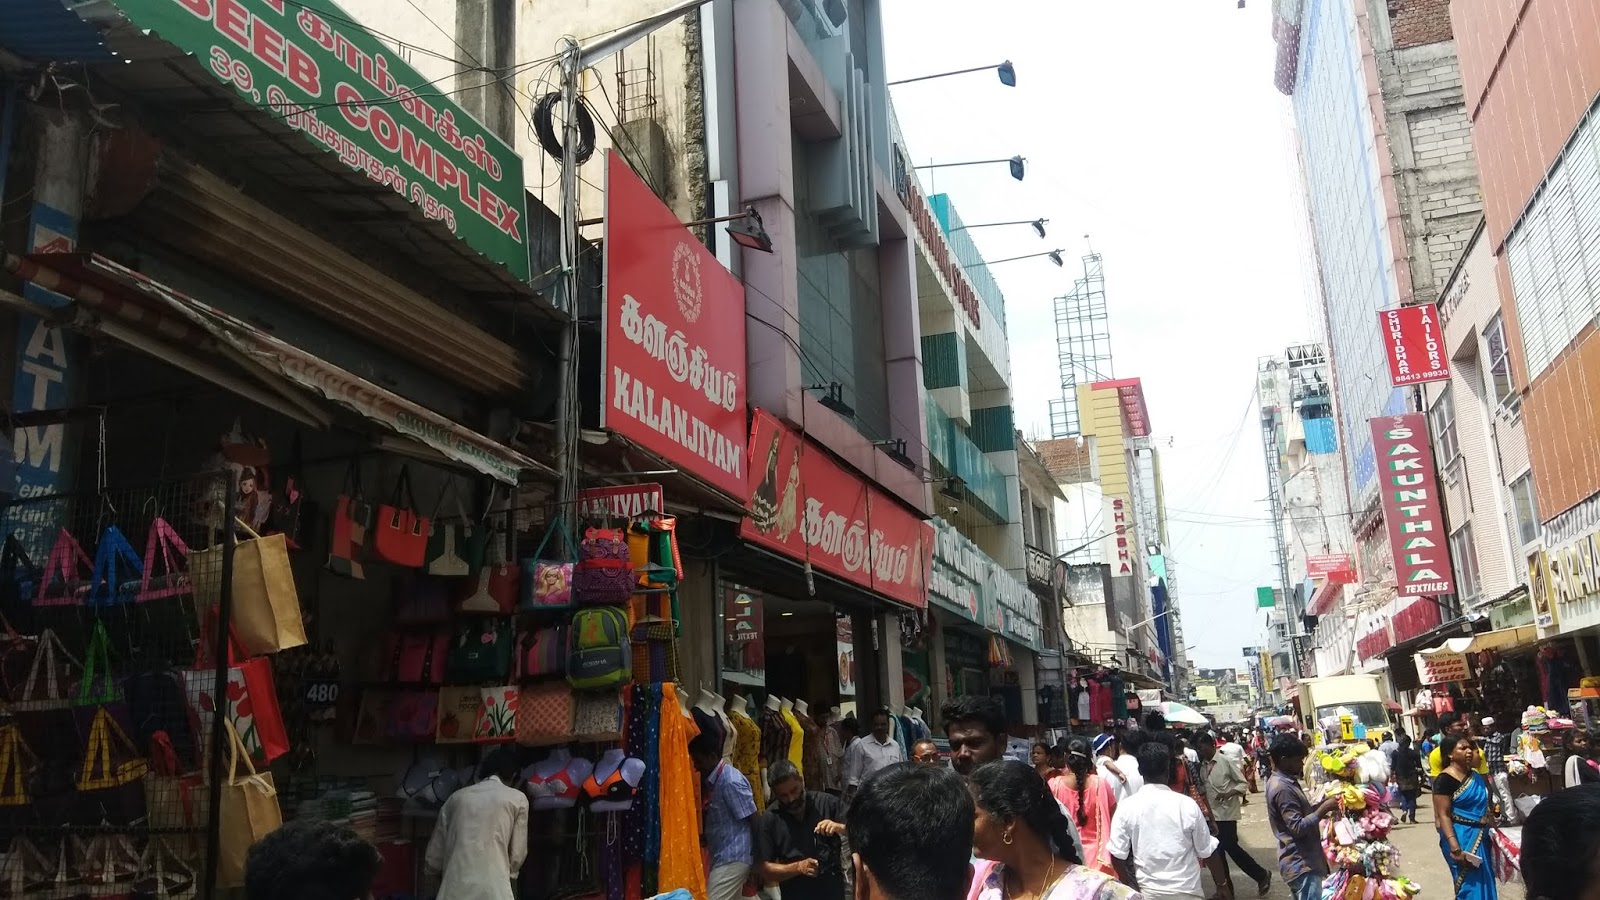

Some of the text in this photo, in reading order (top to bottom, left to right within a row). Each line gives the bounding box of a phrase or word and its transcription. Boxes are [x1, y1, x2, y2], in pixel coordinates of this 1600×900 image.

[210, 45, 261, 103] 39,
[334, 81, 523, 244] COMPLEX
[620, 293, 737, 413] களஞ்சியம்
[1387, 310, 1410, 374] CHURIDHAR
[1418, 305, 1441, 370] TAILORS
[13, 316, 67, 474] ATM
[1395, 373, 1421, 383] 98413
[613, 365, 741, 479] KALANJIYAM
[799, 497, 909, 585] களஞ்சியம்
[1112, 499, 1132, 573] SHOBHA
[1386, 427, 1442, 582] SAKUNTHALA
[1404, 581, 1449, 594] TEXTILES
[307, 683, 339, 702] 480
